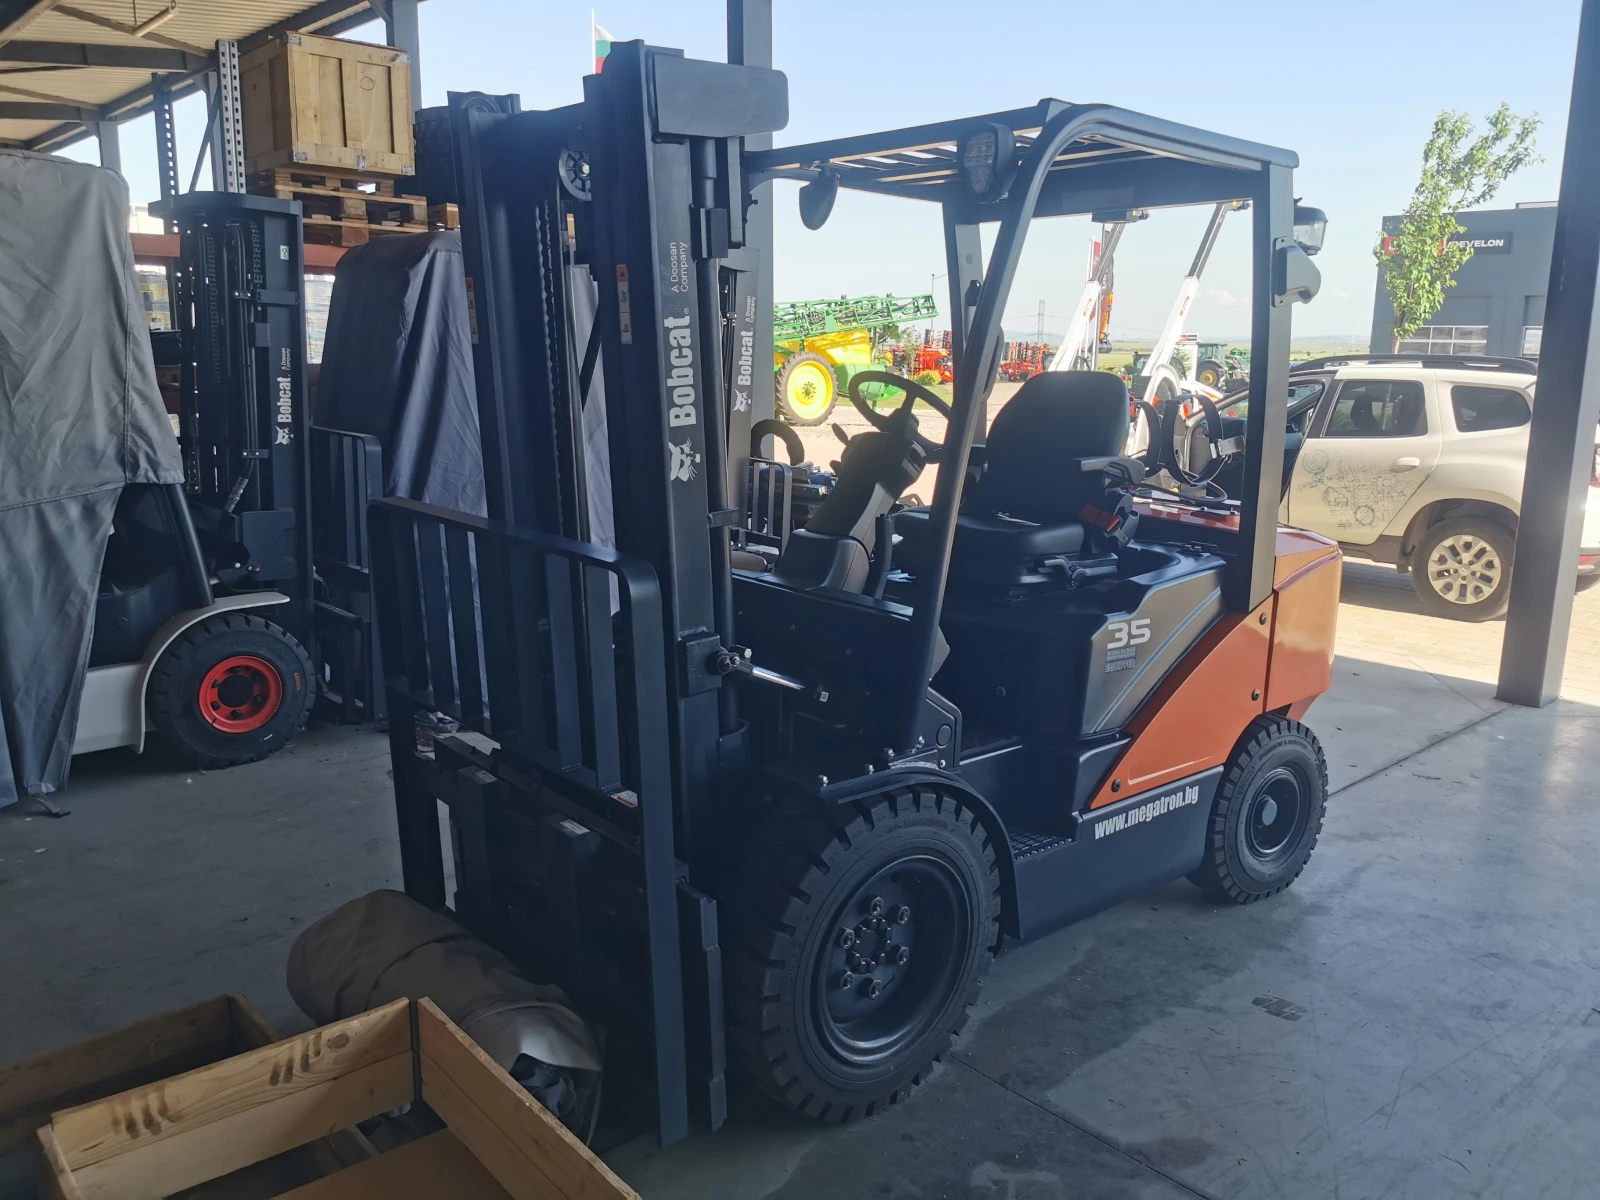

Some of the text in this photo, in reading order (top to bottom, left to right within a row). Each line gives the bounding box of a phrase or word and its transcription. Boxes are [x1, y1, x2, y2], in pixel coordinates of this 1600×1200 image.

[670, 242, 679, 282] Doosan
[679, 241, 689, 292] Company
[664, 316, 696, 427] Bobcat
[738, 331, 753, 385] Bobcat
[277, 377, 292, 422] Bobcat
[1107, 618, 1150, 649] 35
[1094, 785, 1199, 840] www.megatron.bg
